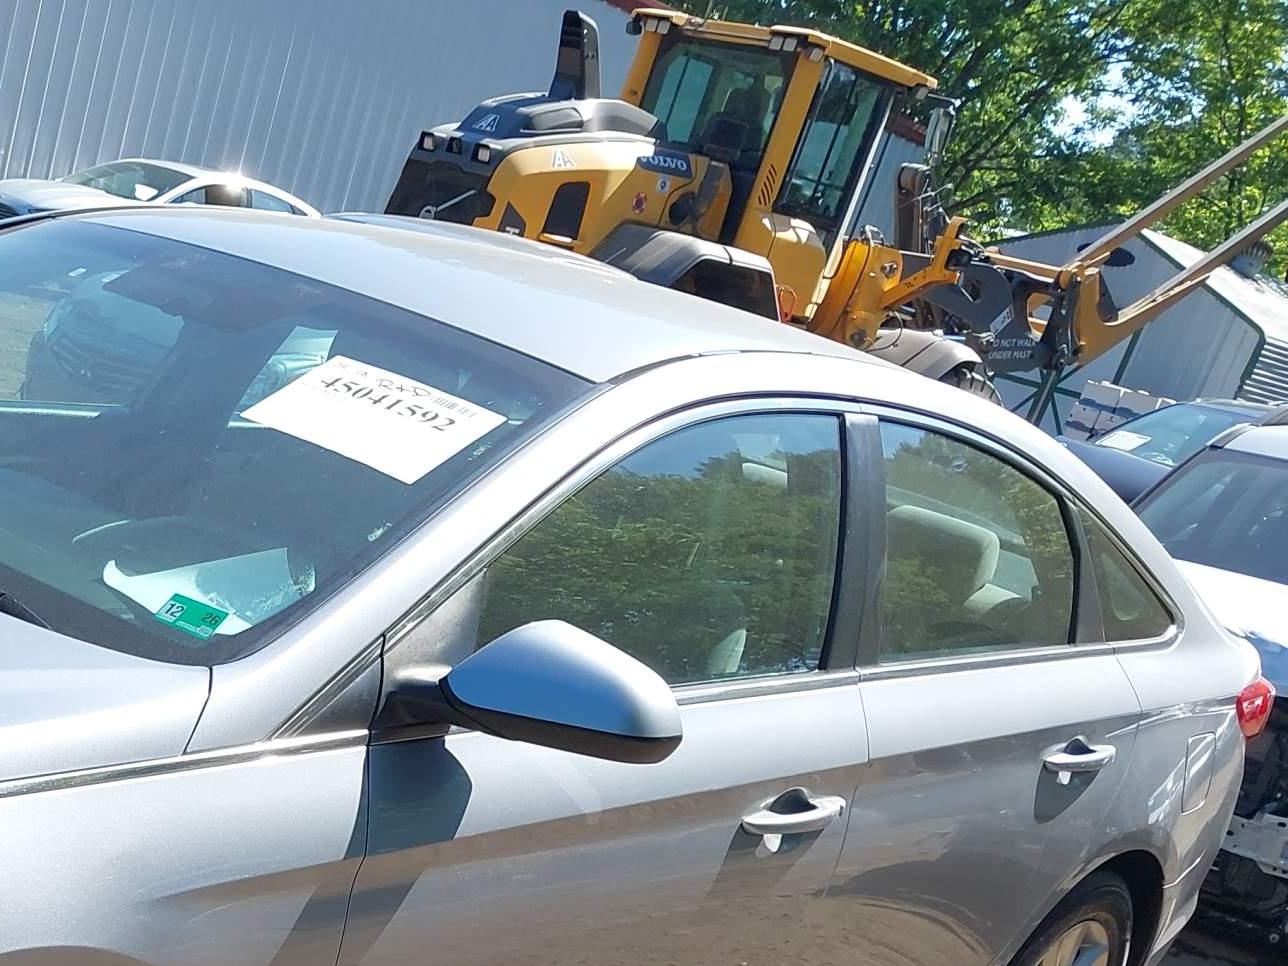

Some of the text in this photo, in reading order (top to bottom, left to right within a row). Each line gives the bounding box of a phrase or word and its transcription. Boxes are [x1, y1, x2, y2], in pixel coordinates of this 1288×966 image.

[640, 155, 688, 171] VOLVO
[1000, 339, 1016, 347] NOT
[988, 350, 1032, 360] UNDER MAST
[320, 376, 457, 432] 45041592
[164, 603, 185, 618] 12
[201, 613, 221, 626] 26
